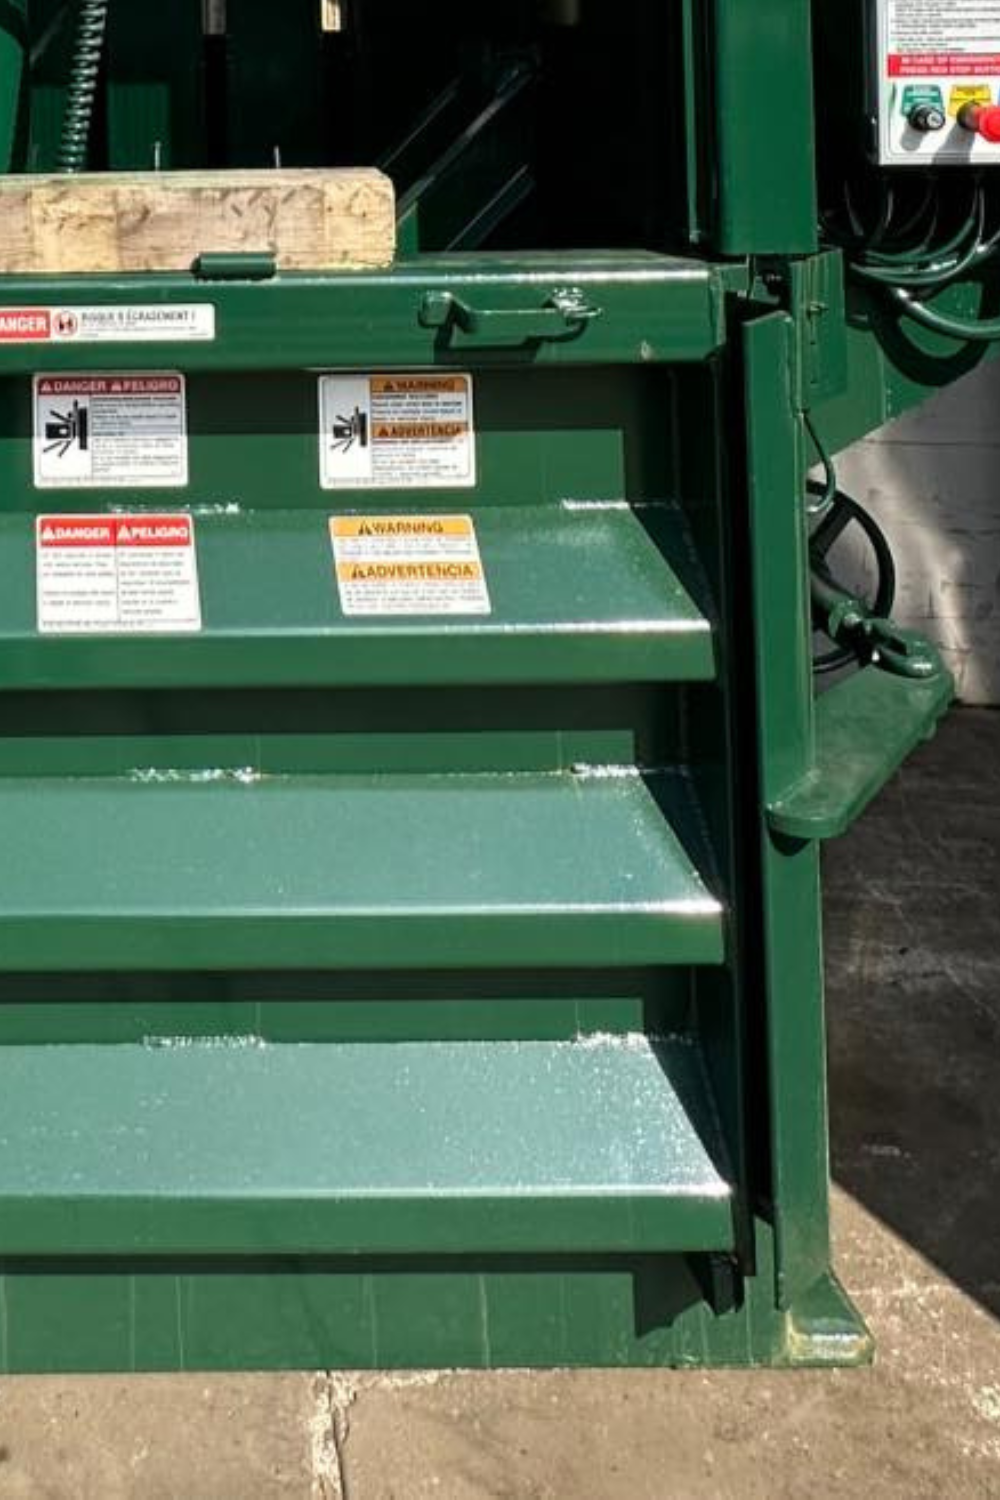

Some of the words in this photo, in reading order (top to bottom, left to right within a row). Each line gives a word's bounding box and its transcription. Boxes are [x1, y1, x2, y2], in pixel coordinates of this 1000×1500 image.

[53, 380, 106, 393] DANGER
[123, 379, 179, 392] PELIGRO
[56, 527, 111, 539] DANGER
[131, 525, 189, 538] PELIGRO
[372, 520, 443, 534] WARNING
[366, 562, 474, 579] ADVERTENCIA
